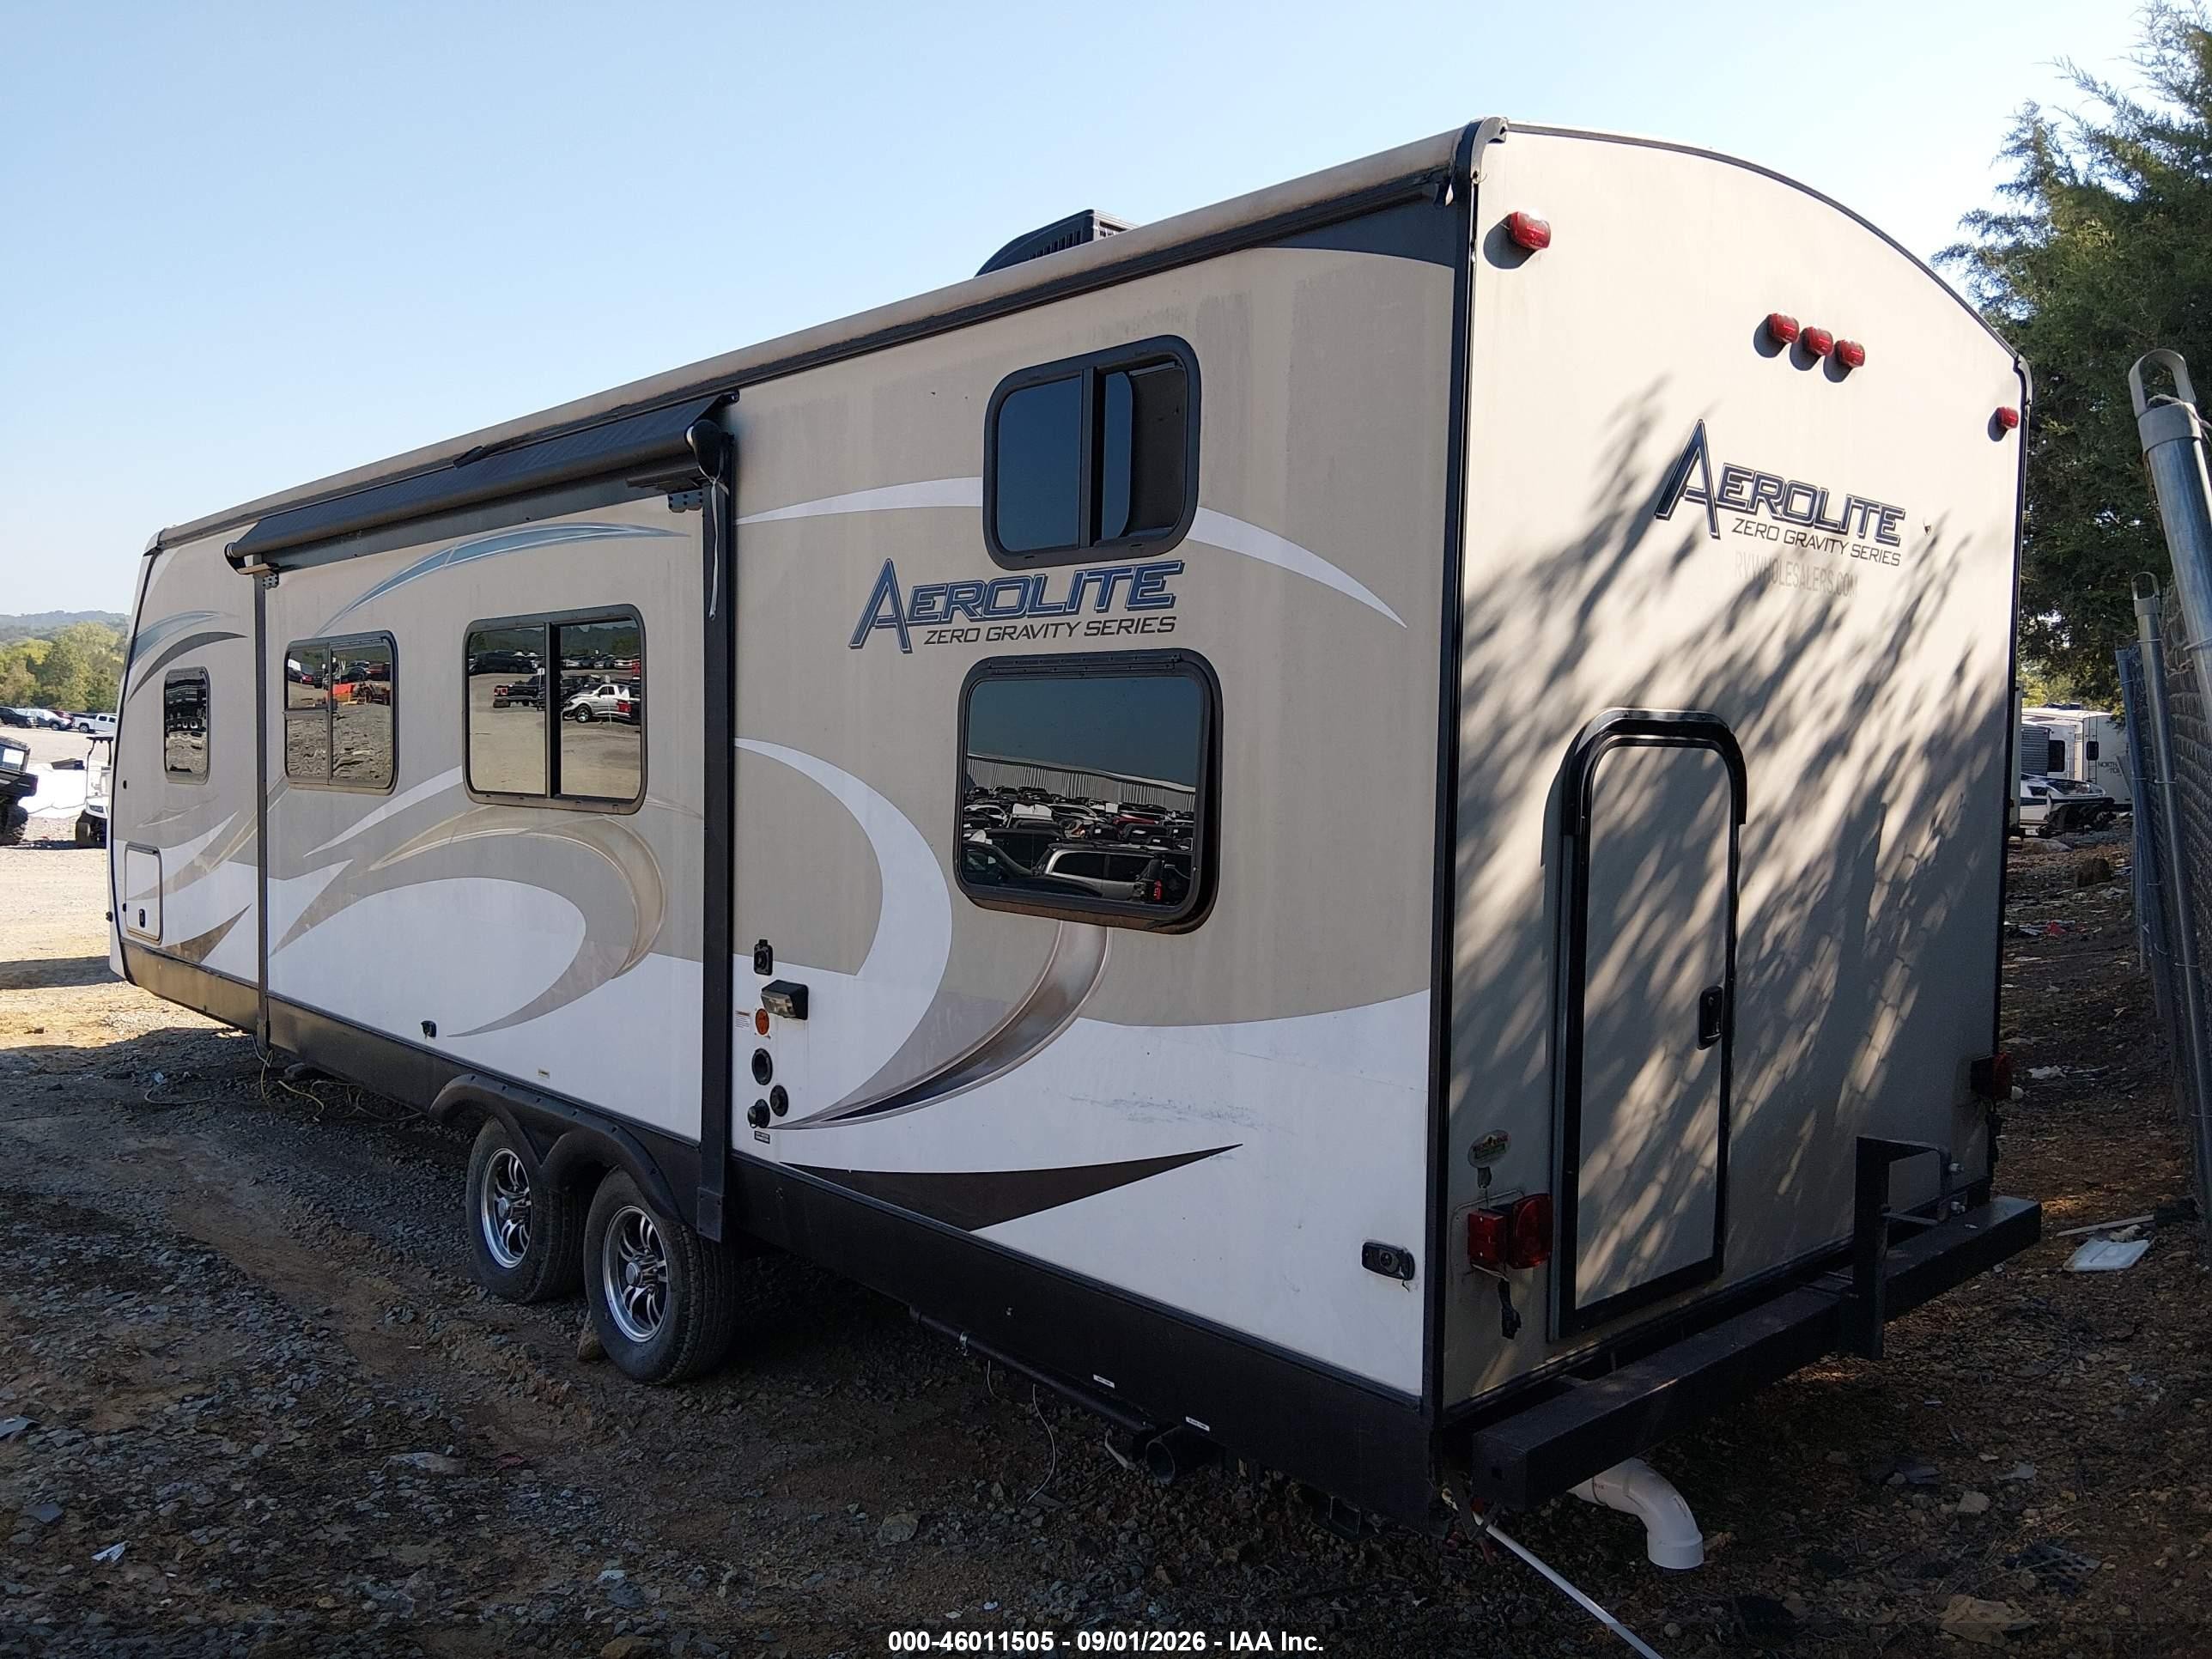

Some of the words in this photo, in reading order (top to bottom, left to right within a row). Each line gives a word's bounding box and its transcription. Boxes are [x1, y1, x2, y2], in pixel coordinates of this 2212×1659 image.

[1654, 418, 1905, 547] AEROLITE
[1732, 518, 1779, 541] ZERO
[1784, 530, 1849, 556] GRAVITY
[1850, 544, 1901, 567] SERIES
[848, 558, 1185, 653] AEROLITE
[924, 627, 981, 646] ZERO
[986, 621, 1080, 642] GRAVITY
[1083, 616, 1177, 636] SERIES
